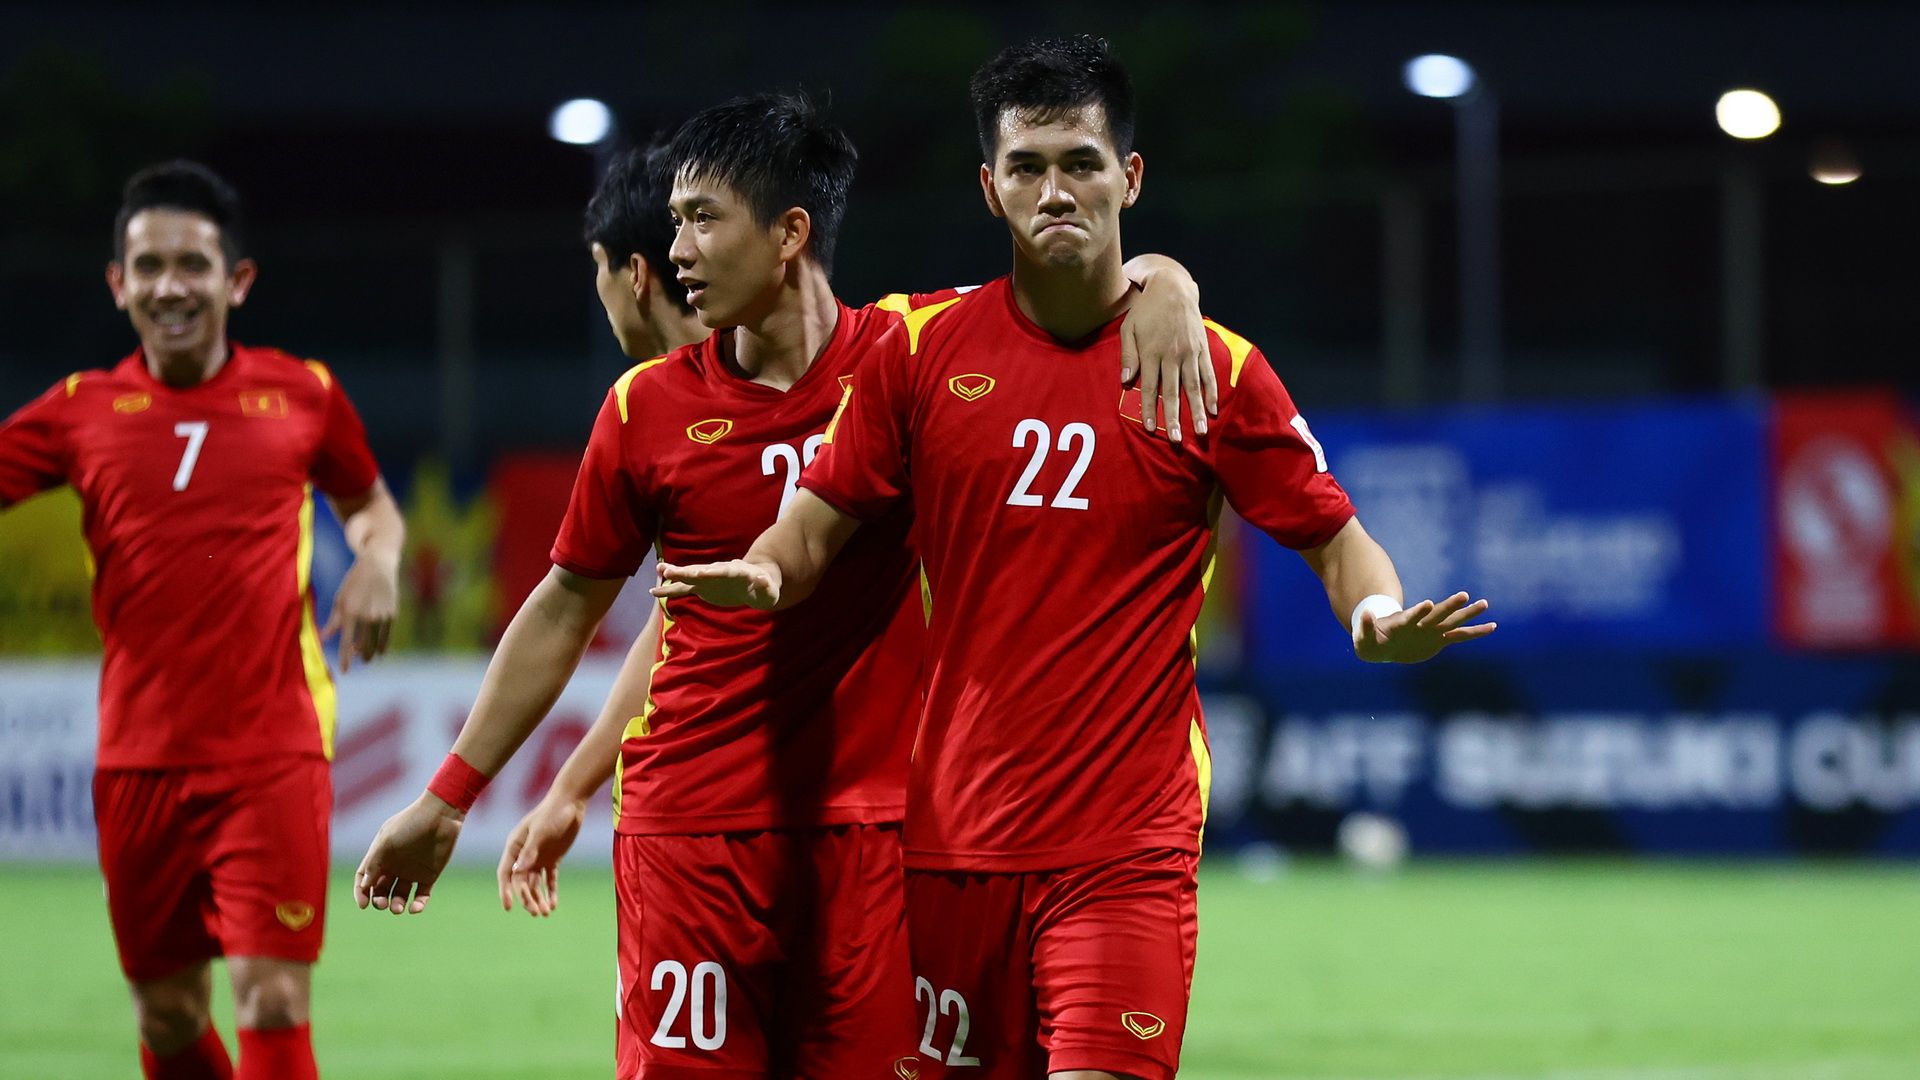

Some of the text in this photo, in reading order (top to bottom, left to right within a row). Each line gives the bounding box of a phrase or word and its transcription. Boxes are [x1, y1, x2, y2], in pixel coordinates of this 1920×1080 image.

[173, 422, 209, 491] 7
[761, 433, 825, 523] 2
[1006, 418, 1097, 511] 22
[650, 960, 727, 1050] 20
[915, 976, 981, 1067] 22
